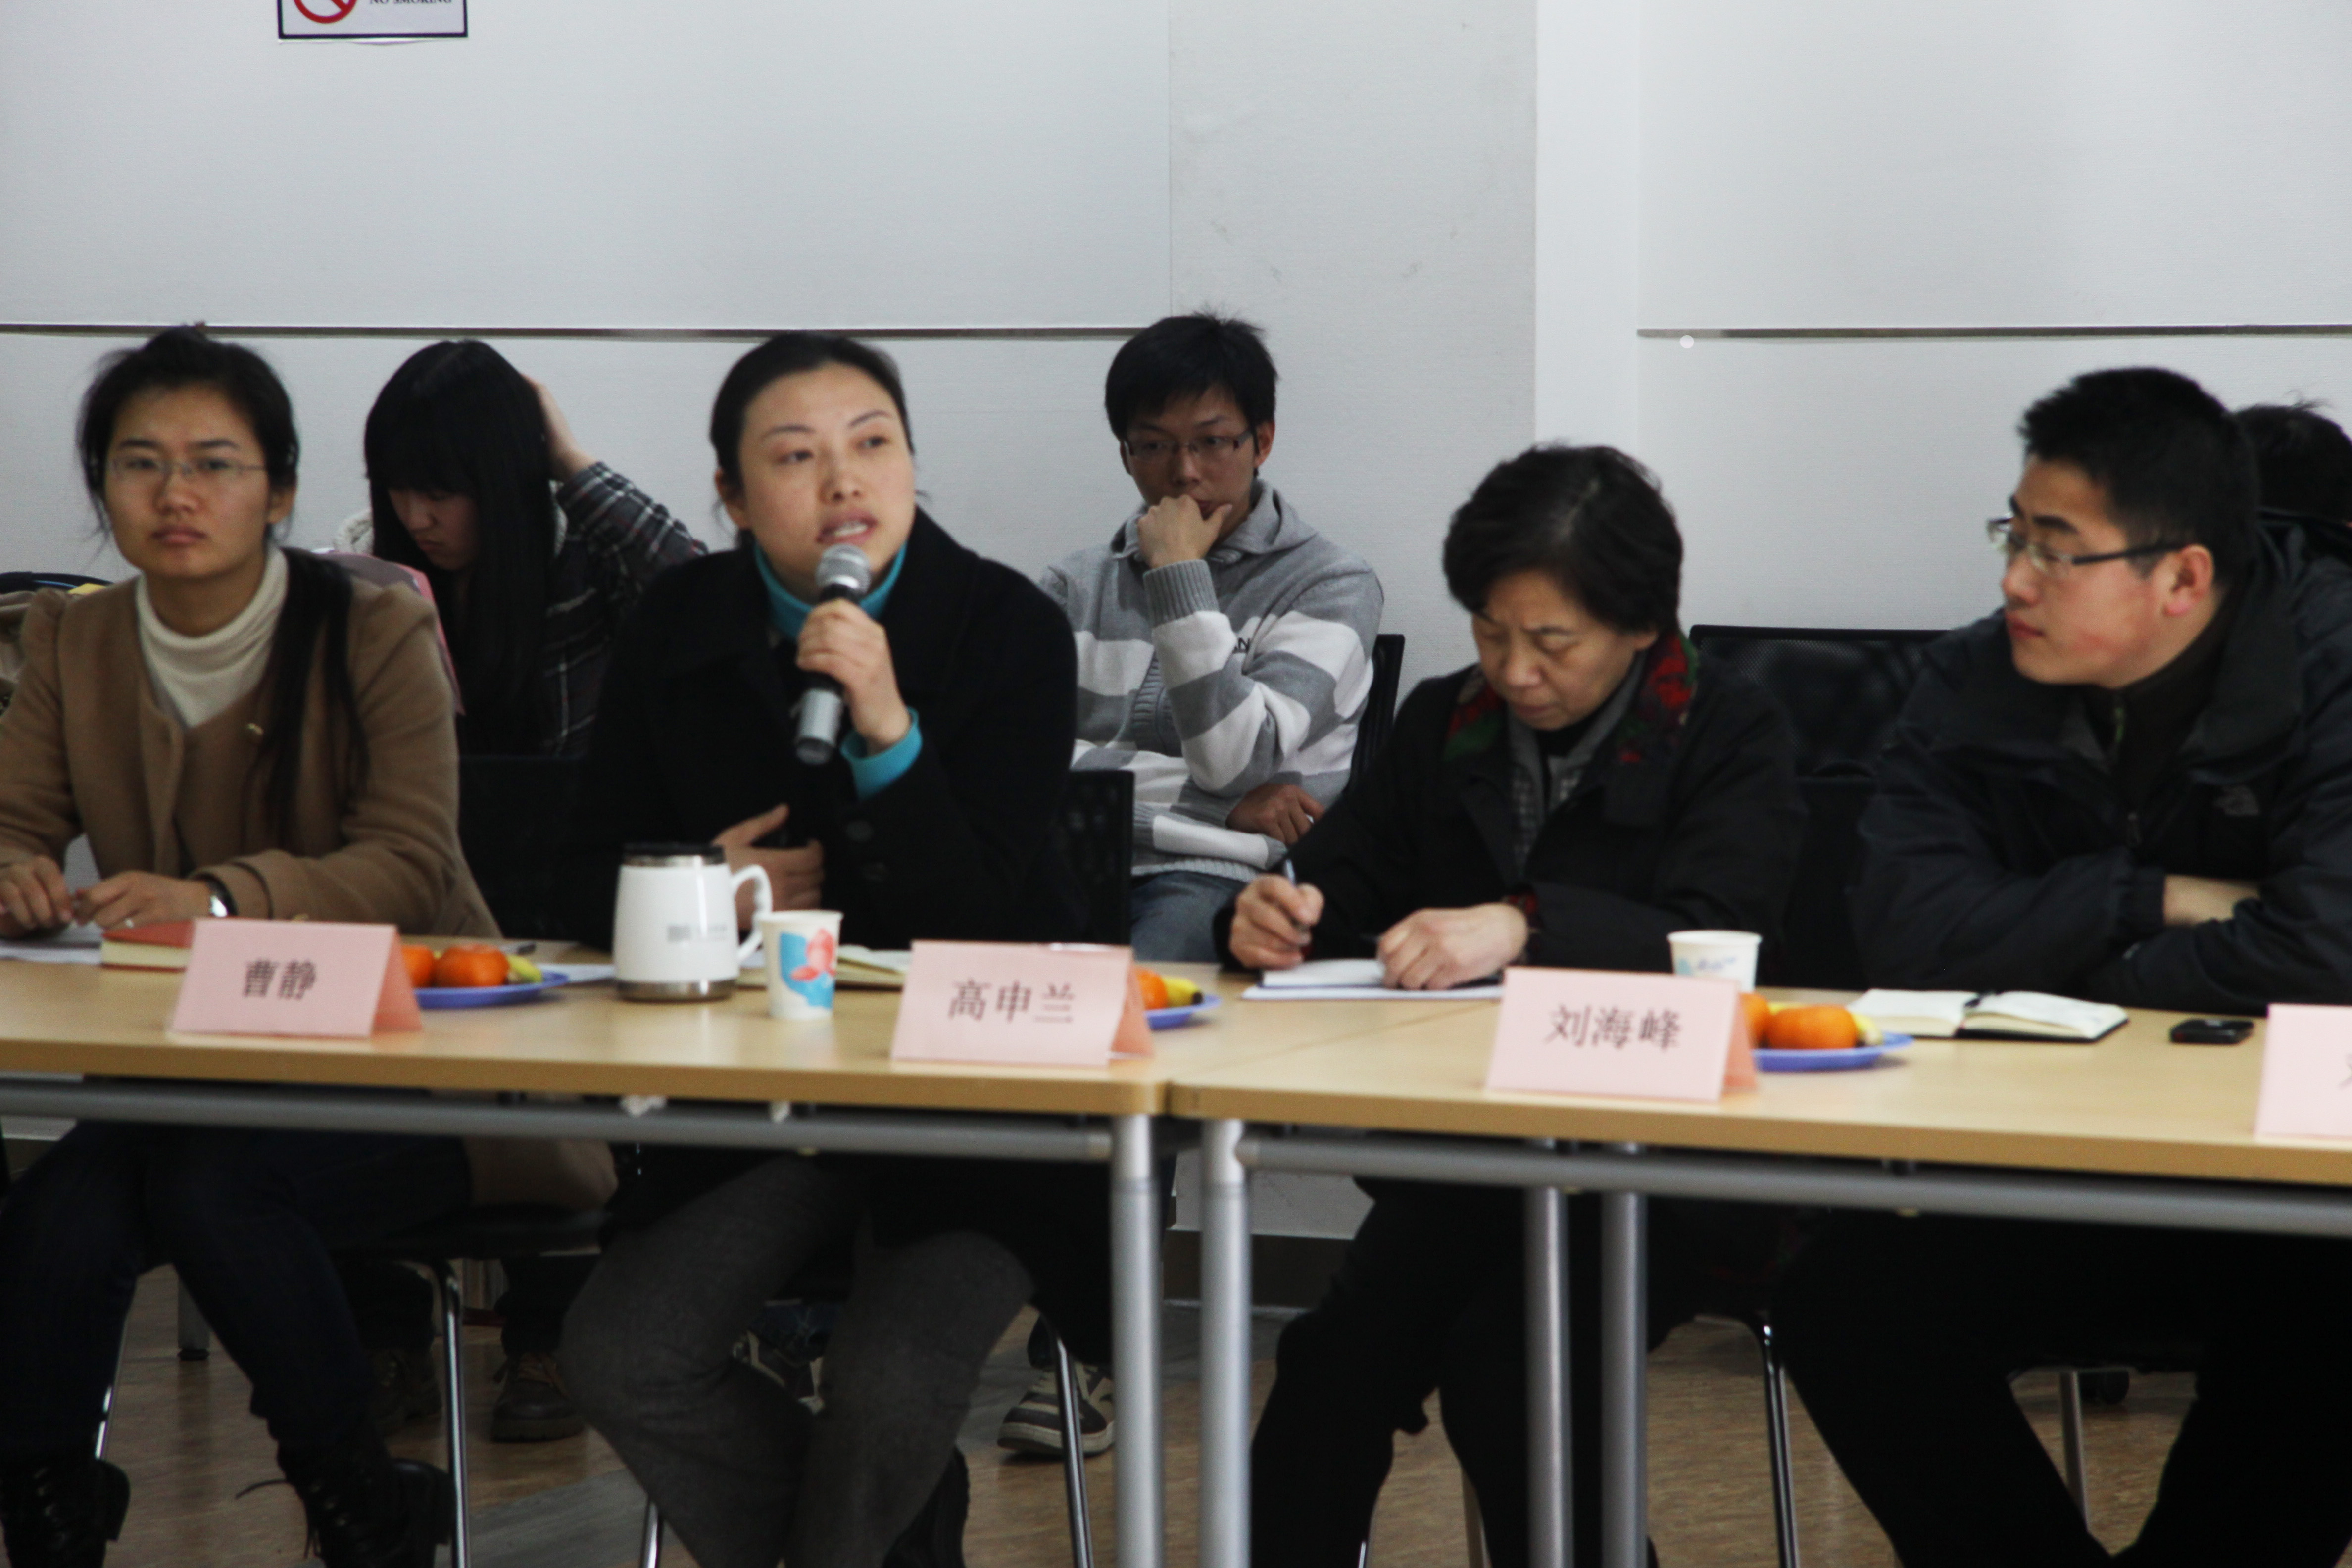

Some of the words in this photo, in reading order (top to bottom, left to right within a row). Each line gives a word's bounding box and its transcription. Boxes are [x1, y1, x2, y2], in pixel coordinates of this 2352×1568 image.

[242, 957, 317, 1000] 曹静
[947, 978, 1076, 1023] 高申兰
[1544, 1004, 1682, 1051] 刘海峰
